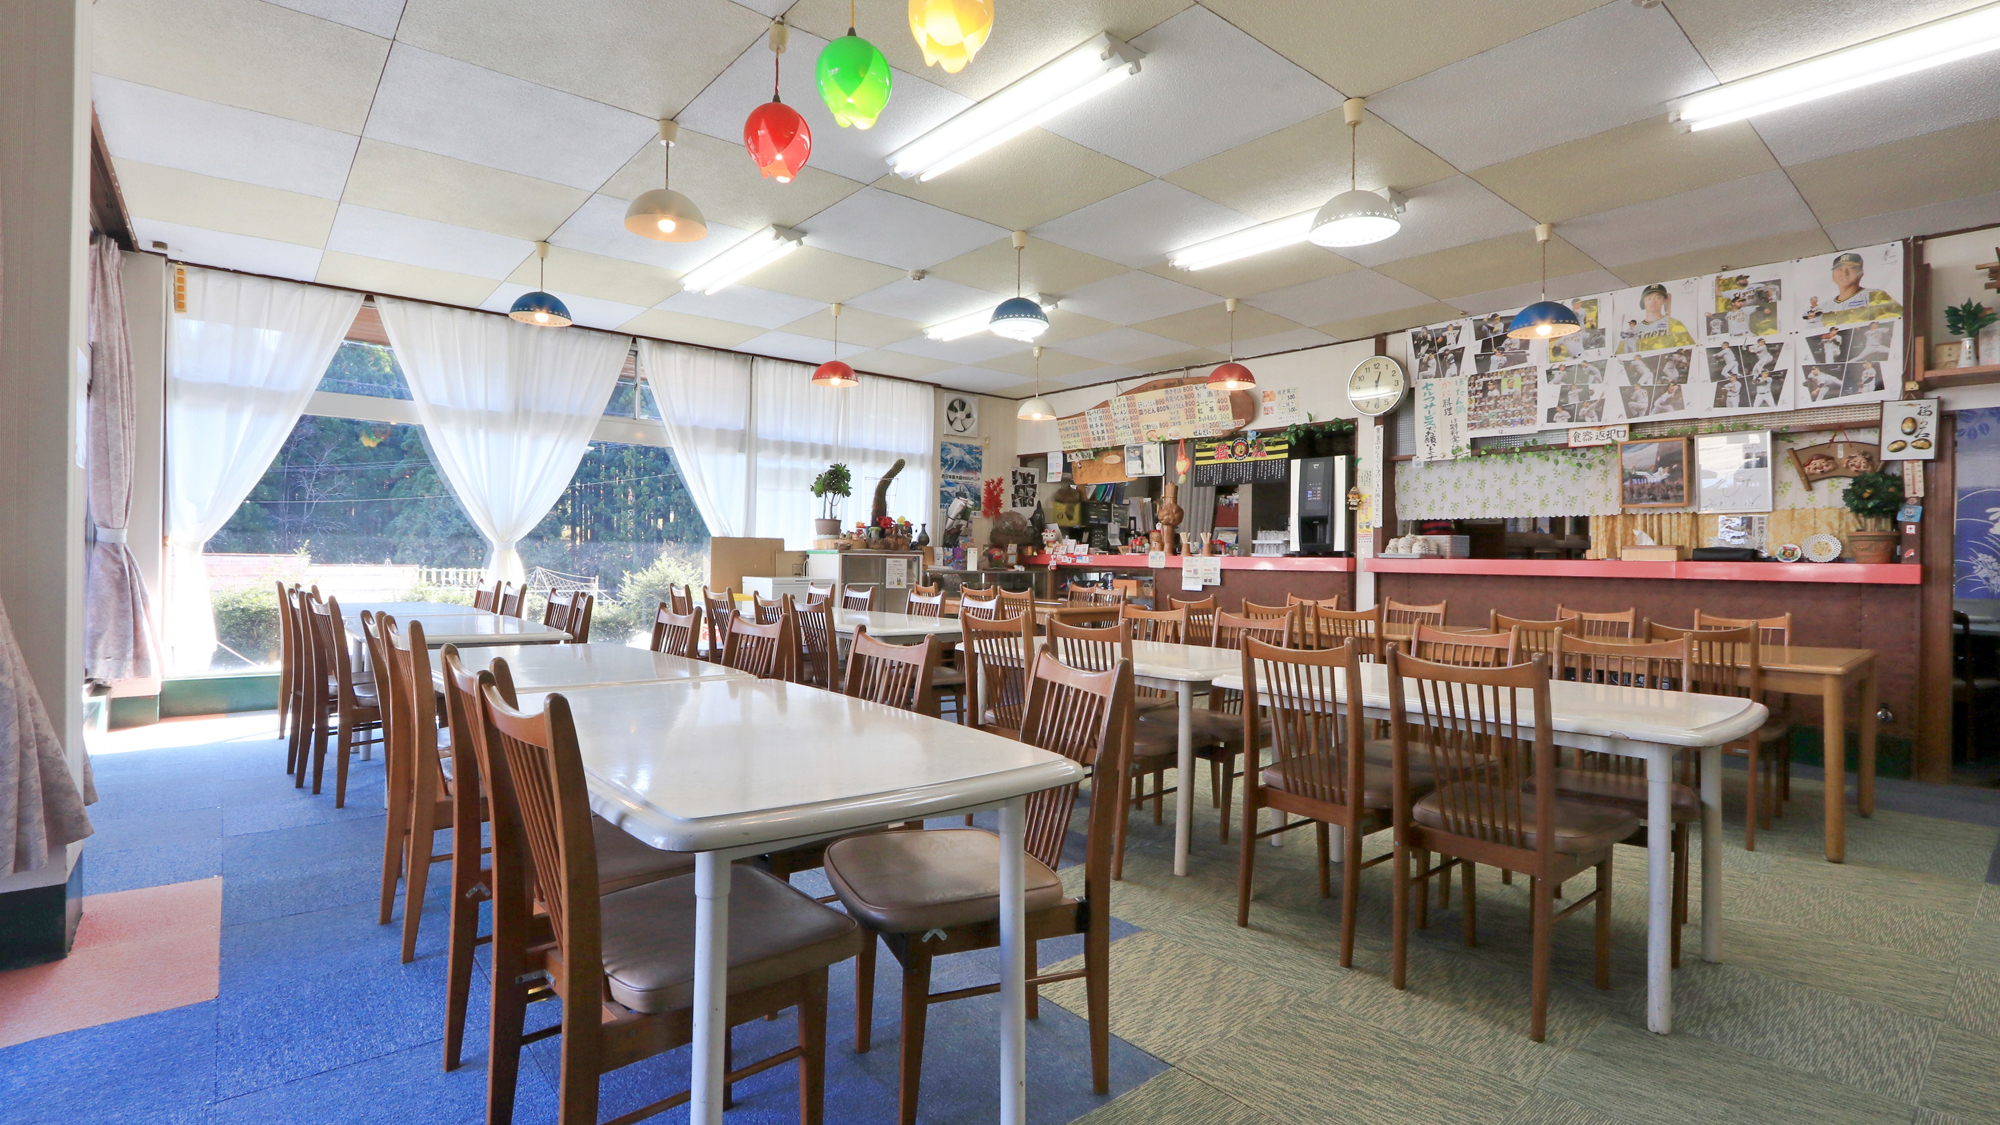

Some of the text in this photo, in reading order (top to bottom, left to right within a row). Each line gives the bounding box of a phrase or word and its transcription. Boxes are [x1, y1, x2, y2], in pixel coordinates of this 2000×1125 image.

[1572, 429, 1626, 442] 食器返却口
